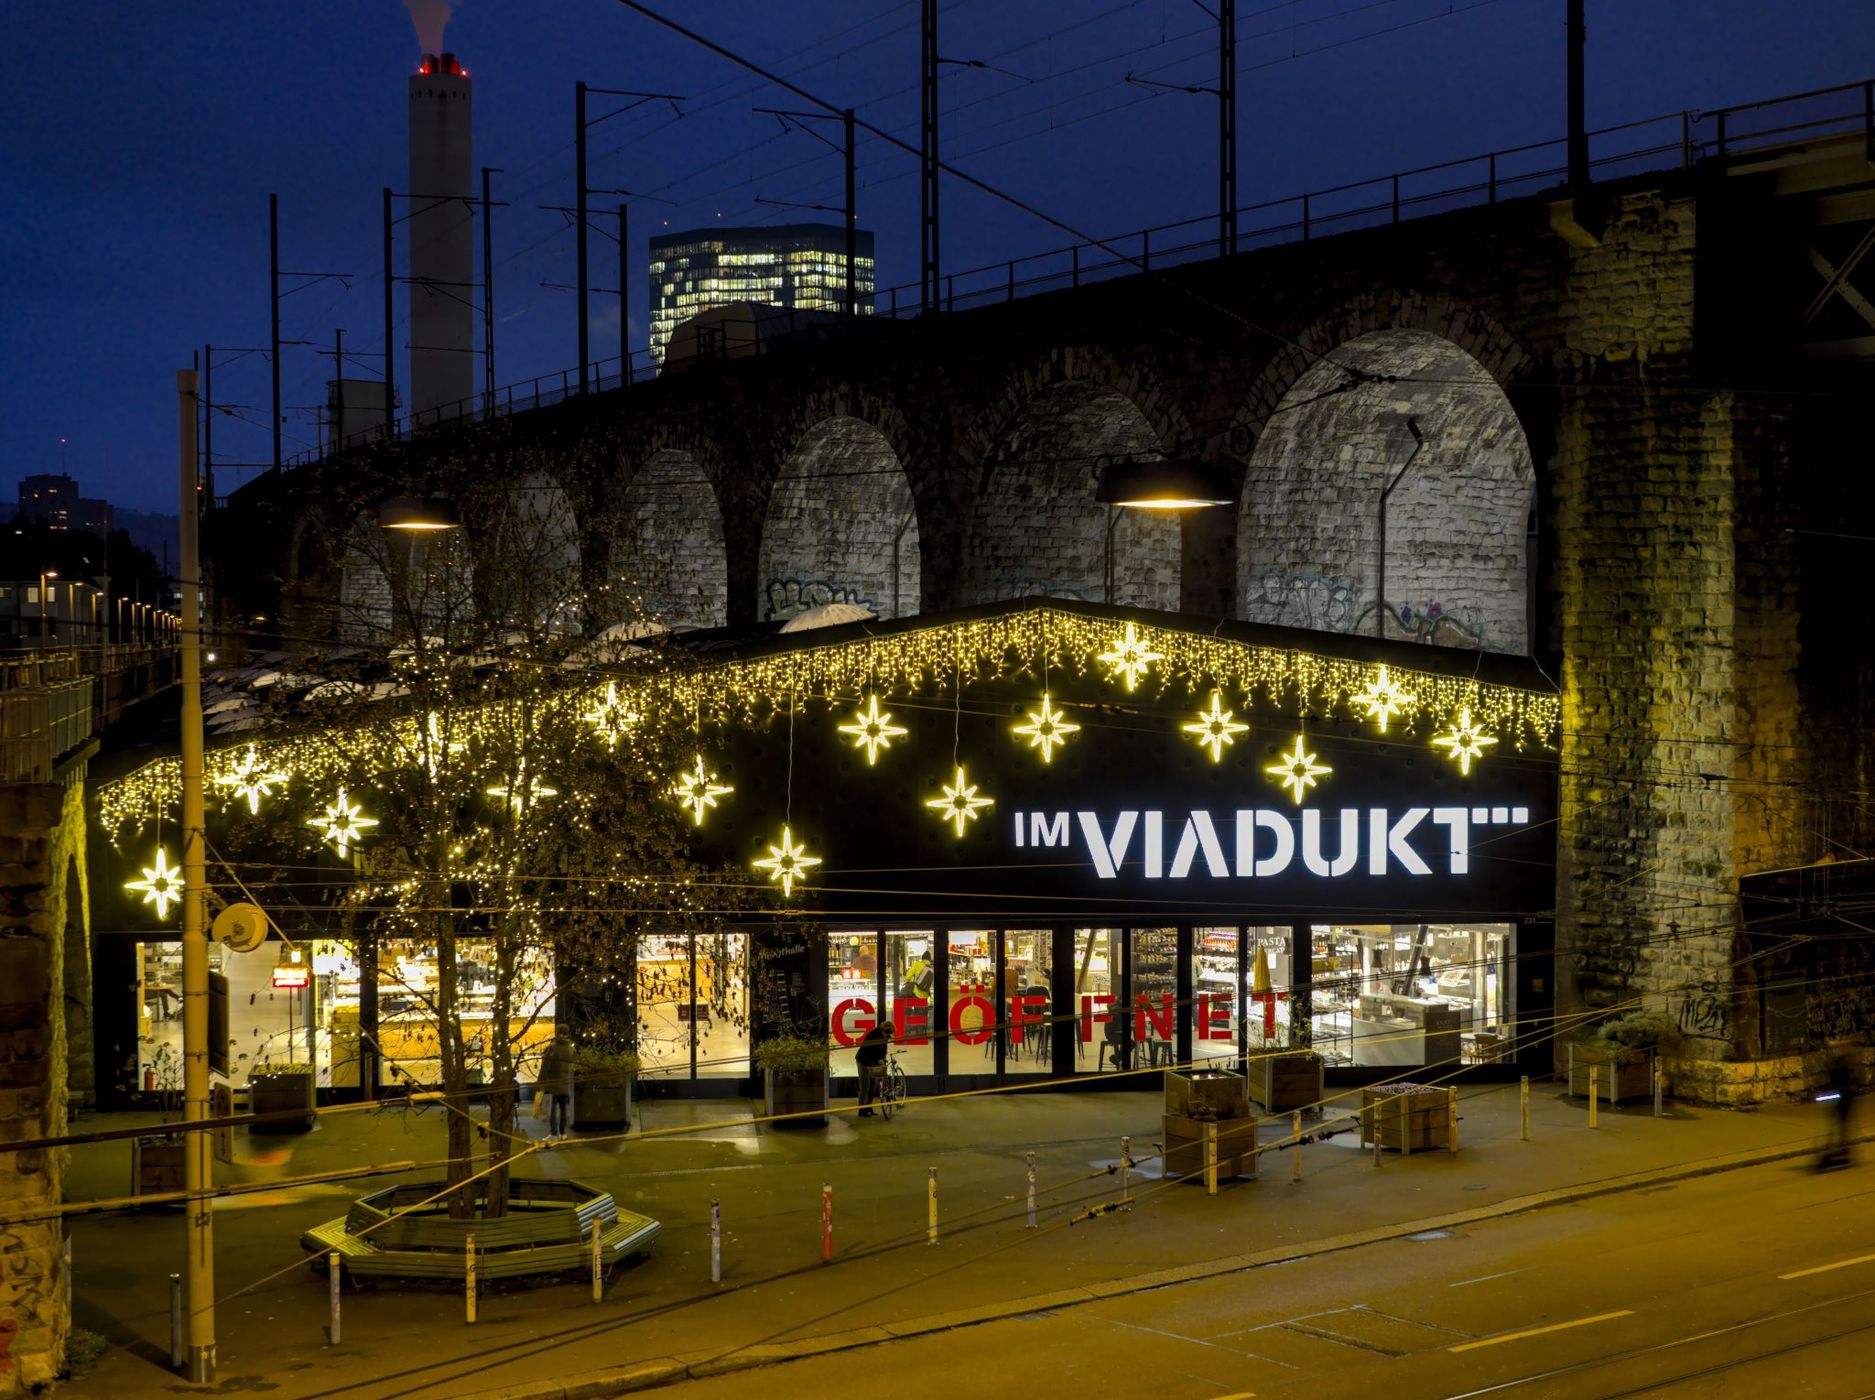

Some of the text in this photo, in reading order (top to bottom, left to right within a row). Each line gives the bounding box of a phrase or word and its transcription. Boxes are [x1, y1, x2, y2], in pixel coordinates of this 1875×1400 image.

[1015, 807, 1469, 878] IM VIADUKT
[1257, 937, 1286, 947] PASTA
